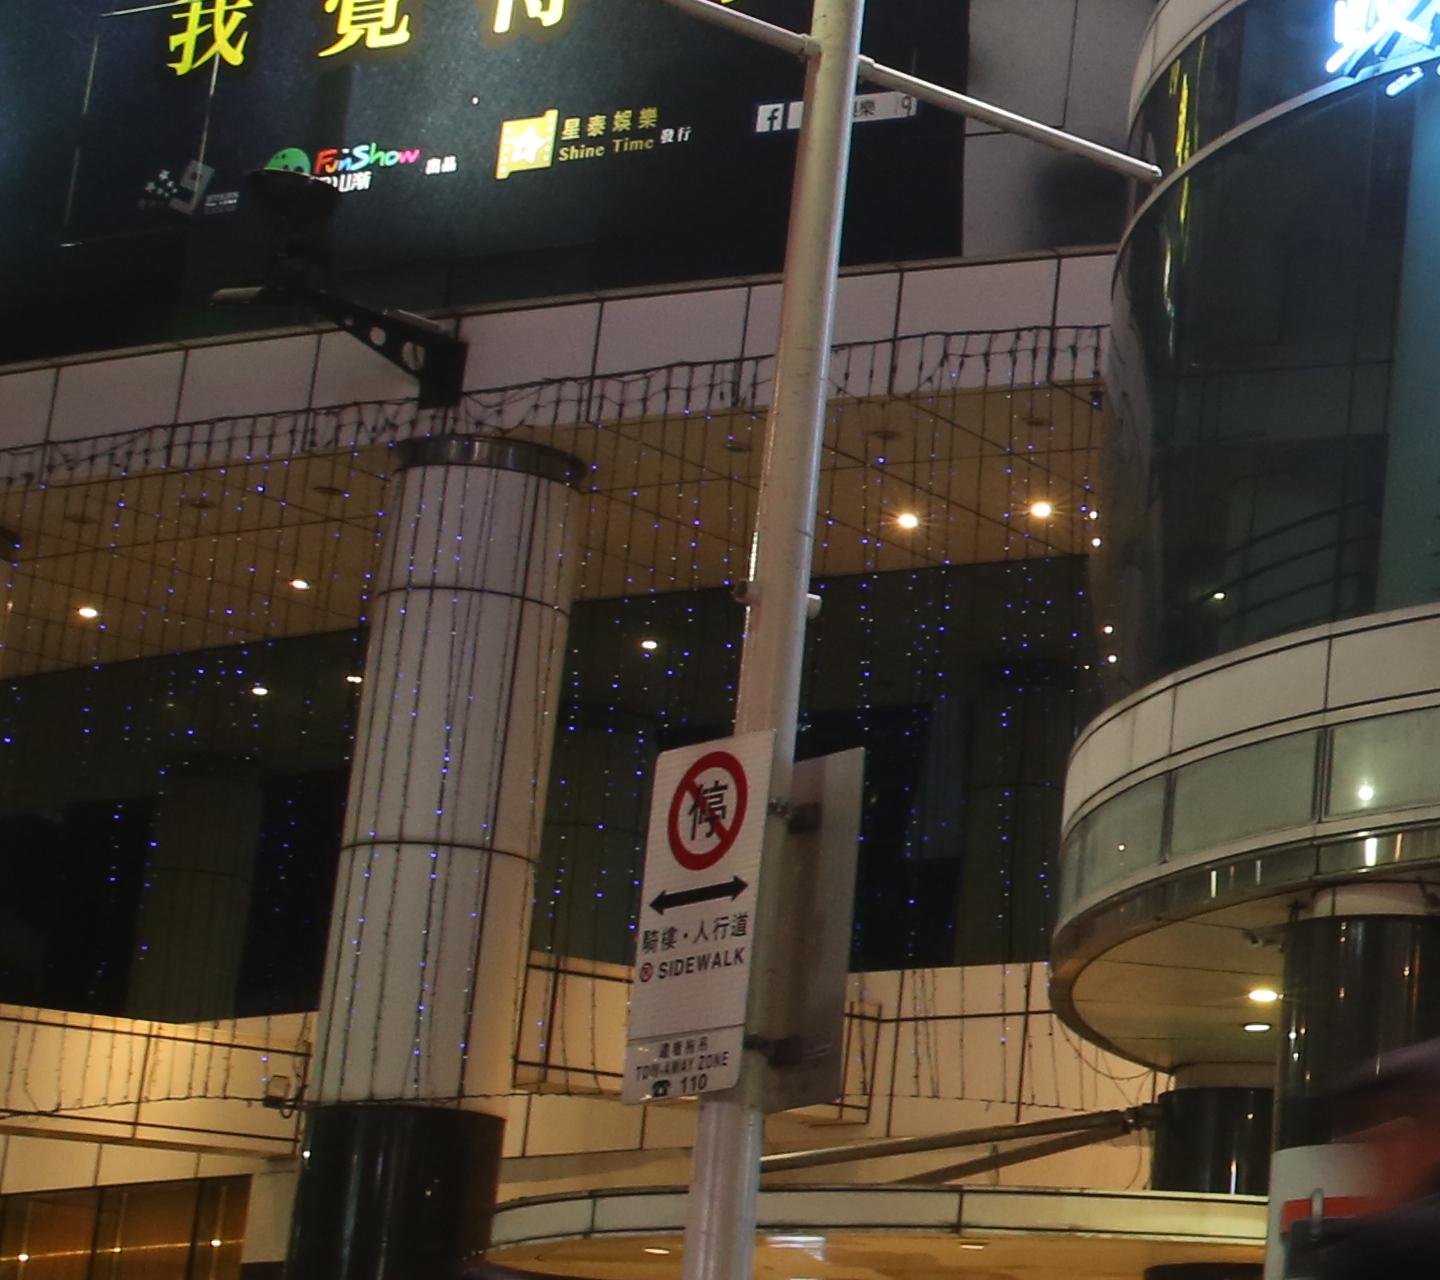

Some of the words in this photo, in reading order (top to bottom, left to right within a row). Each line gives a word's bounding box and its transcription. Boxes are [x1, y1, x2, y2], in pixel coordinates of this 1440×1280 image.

[558, 143, 606, 162] Shine
[612, 136, 654, 154] Time
[688, 780, 729, 841] 停
[657, 947, 746, 979] SIDEWALK
[680, 1073, 708, 1094] 110
